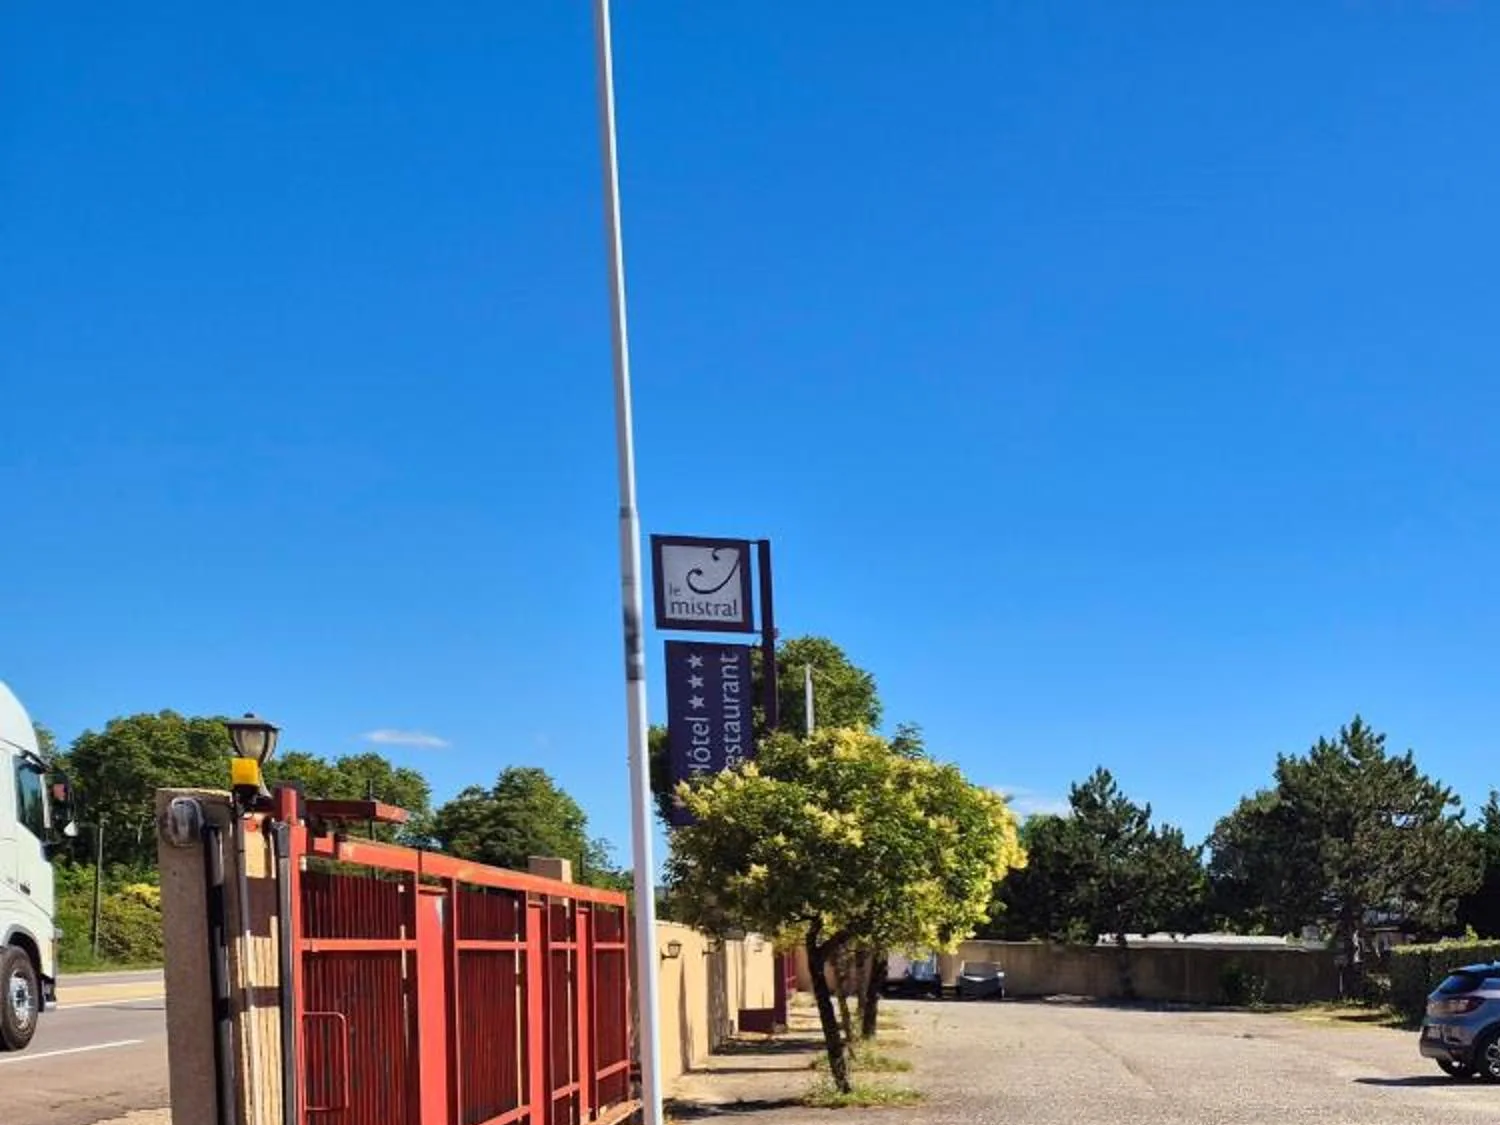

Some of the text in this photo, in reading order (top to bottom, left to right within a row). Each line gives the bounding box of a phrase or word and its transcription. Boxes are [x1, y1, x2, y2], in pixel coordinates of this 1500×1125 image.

[669, 582, 681, 597] le
[671, 598, 737, 617] mistral
[722, 651, 742, 770] estaurant
